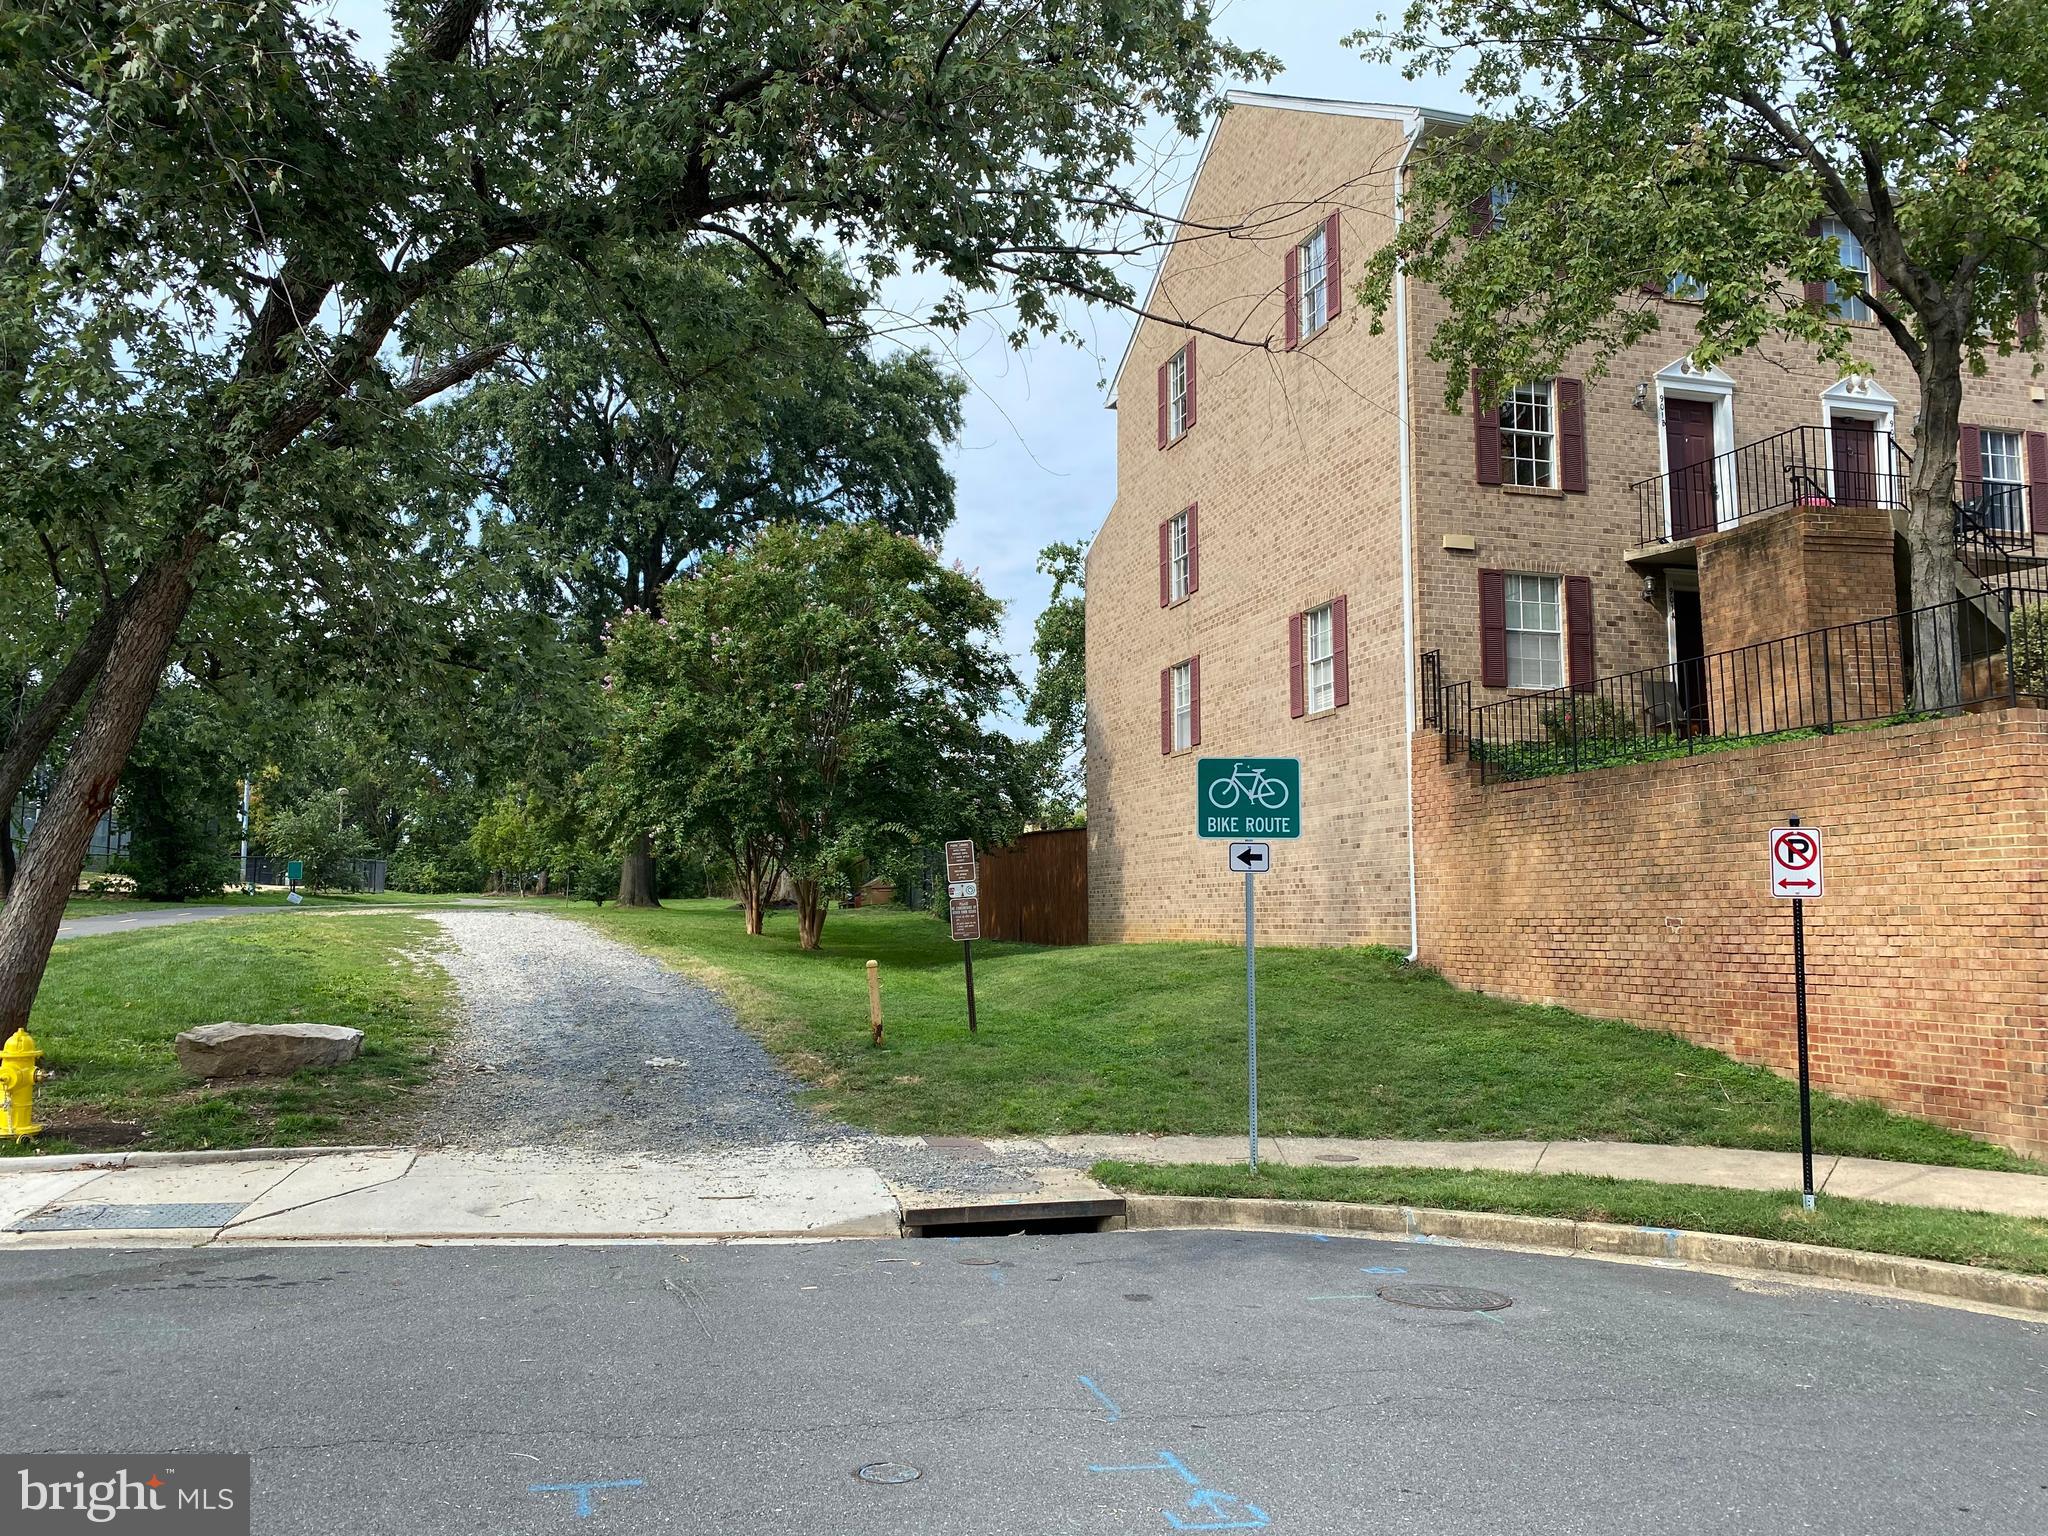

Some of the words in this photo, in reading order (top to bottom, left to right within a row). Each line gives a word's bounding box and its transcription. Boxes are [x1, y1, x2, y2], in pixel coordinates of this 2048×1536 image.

[1207, 816, 1239, 832] BIKE
[1245, 817, 1291, 833] ROUTE
[1787, 838, 1810, 863] P
